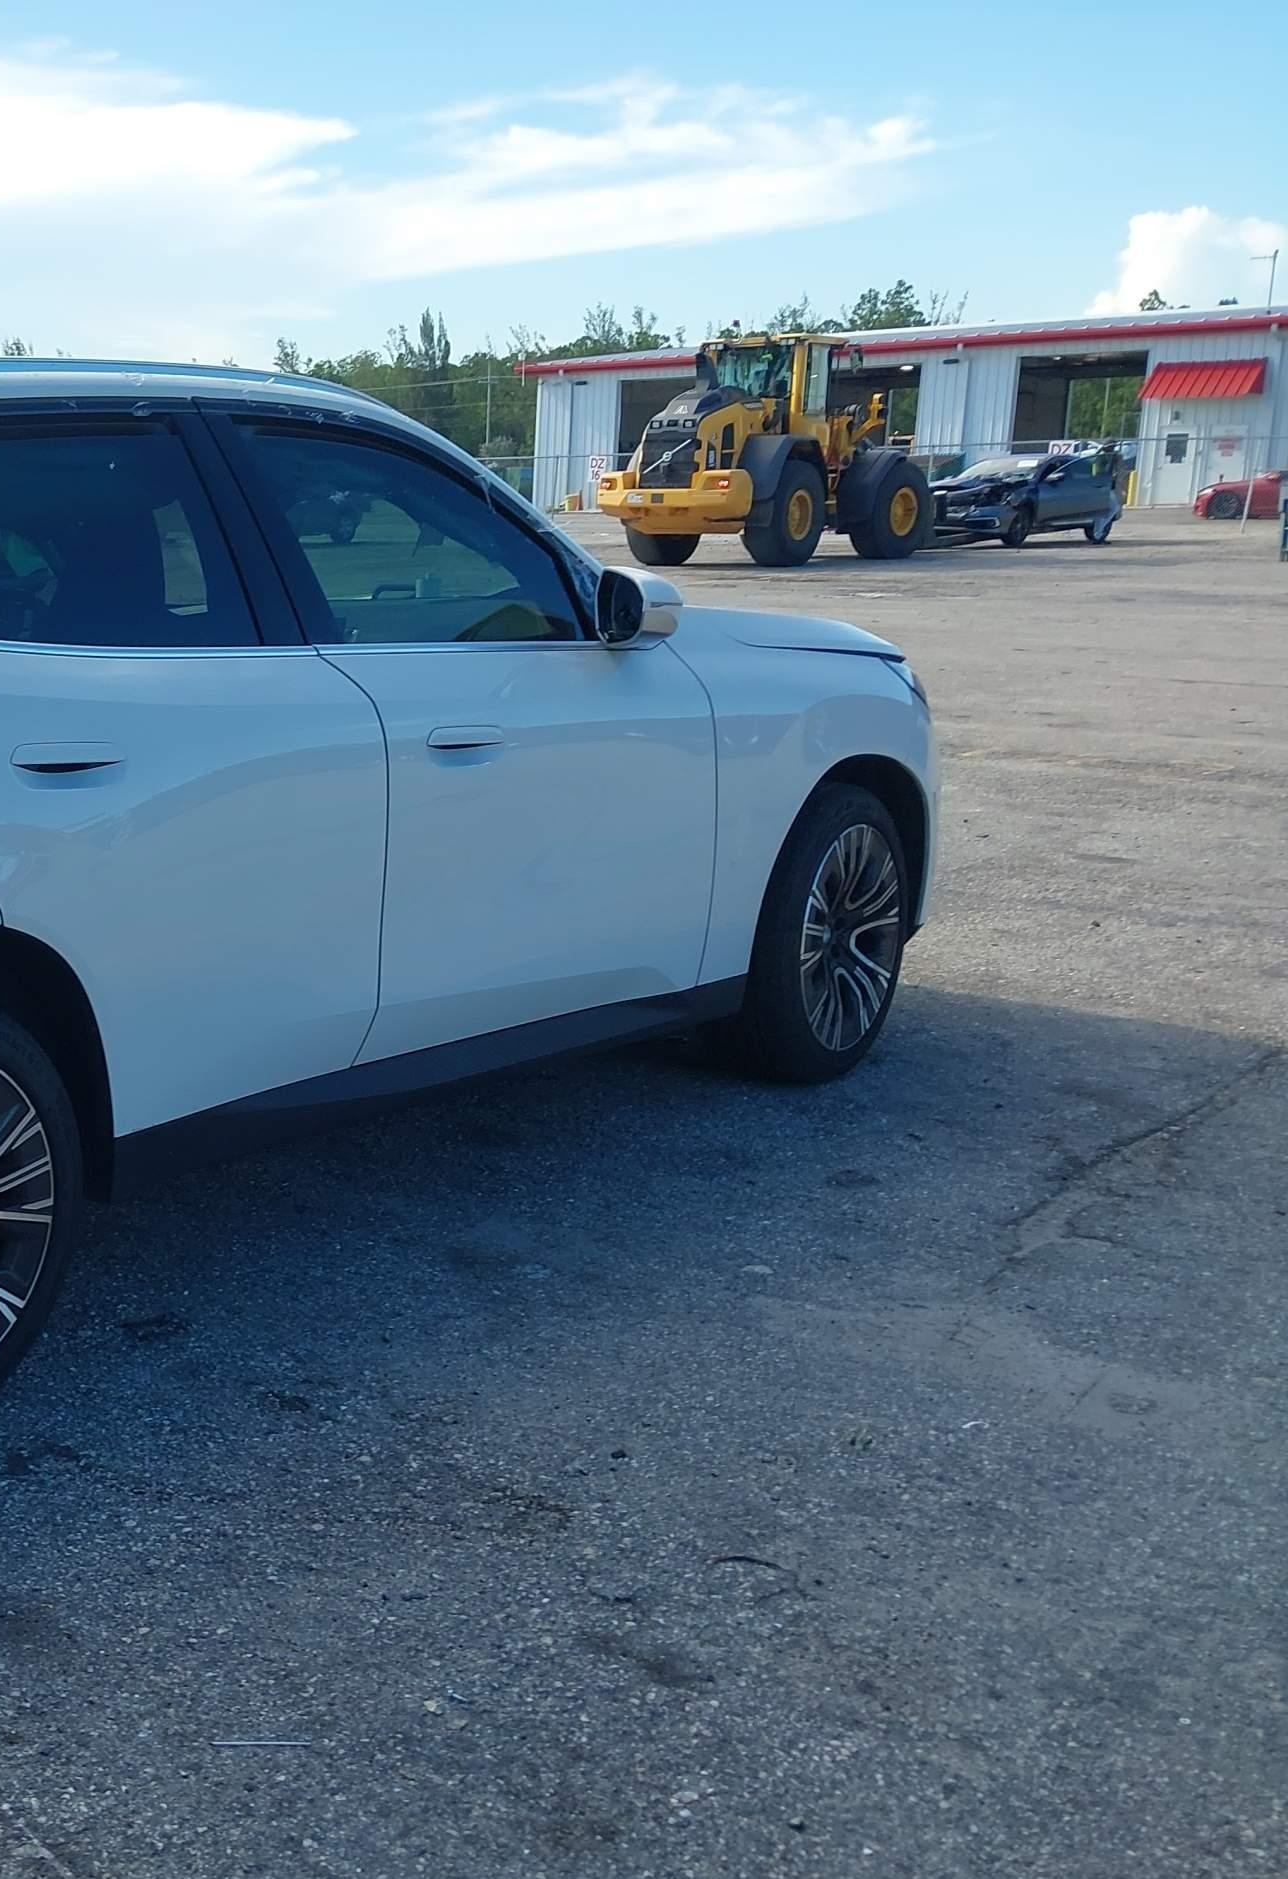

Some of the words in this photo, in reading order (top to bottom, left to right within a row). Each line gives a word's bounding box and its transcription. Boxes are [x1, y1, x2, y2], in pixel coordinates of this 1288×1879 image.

[1052, 444, 1071, 455] DZ
[591, 458, 605, 469] DZ
[592, 470, 600, 480] 16
